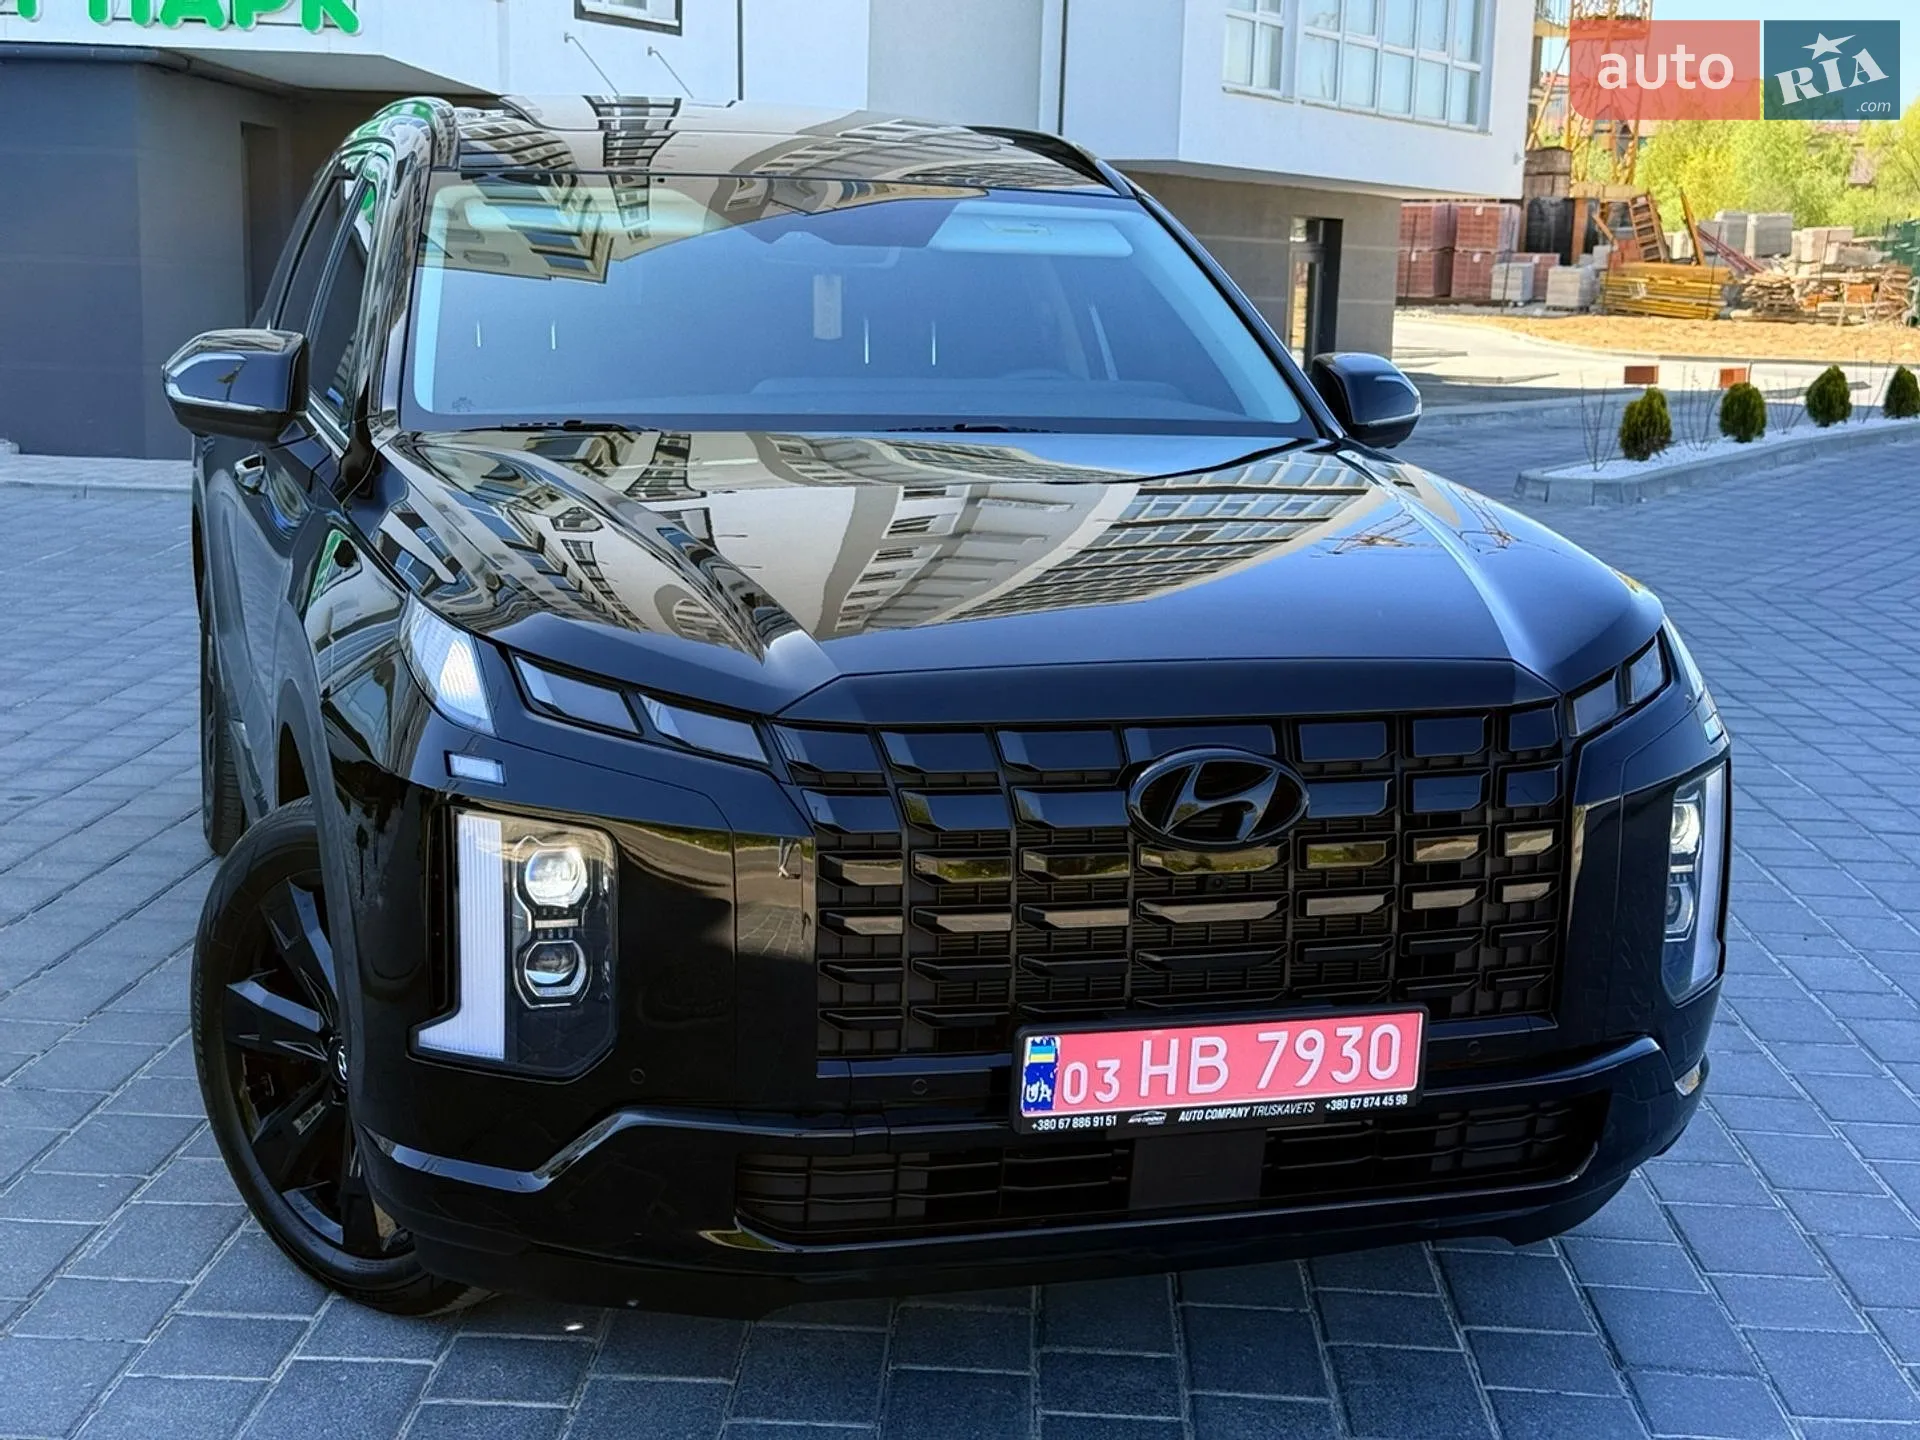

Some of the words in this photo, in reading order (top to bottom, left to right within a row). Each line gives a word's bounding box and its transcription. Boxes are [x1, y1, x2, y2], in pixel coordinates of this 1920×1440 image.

[1062, 1060, 1121, 1105] 03
[1139, 1036, 1229, 1097] HB
[1256, 1023, 1402, 1090] 7930
[1178, 1109, 1203, 1122] AUTO
[1204, 1106, 1251, 1120] COMPANY
[1252, 1101, 1316, 1117] TRUSKAVETS
[1325, 1098, 1348, 1111] +380
[1350, 1097, 1362, 1109] 67
[1363, 1096, 1381, 1108] 874
[1382, 1094, 1394, 1106] 45
[1395, 1093, 1408, 1105] 98
[1032, 1119, 1056, 1131] +380
[1058, 1117, 1071, 1129] 67
